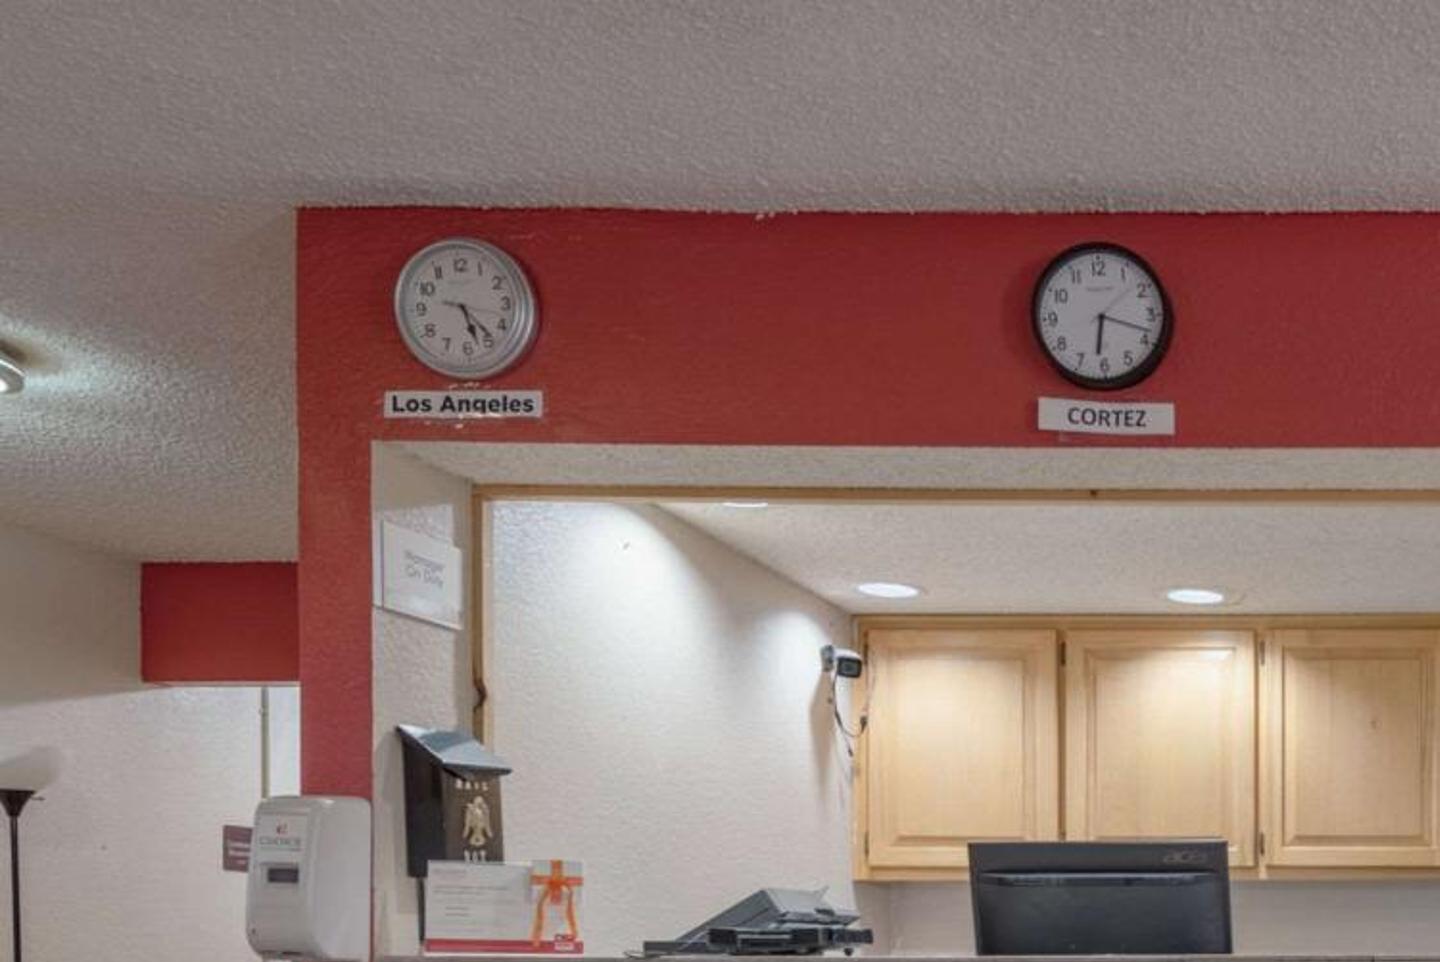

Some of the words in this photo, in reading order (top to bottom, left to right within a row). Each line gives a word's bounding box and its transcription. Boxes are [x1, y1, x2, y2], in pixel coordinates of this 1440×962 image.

[453, 259, 467, 272] 12
[1092, 262, 1105, 276] 12
[493, 276, 503, 290] 2
[1071, 270, 1081, 284] 11
[420, 282, 434, 296] 10
[1055, 289, 1068, 303] 10
[1137, 283, 1147, 297] 2
[416, 303, 427, 316] 9
[502, 297, 511, 311] 3
[1048, 312, 1057, 326] 9
[1146, 308, 1155, 322] 3
[425, 324, 436, 337] 8
[498, 318, 506, 330] 4
[442, 337, 451, 350] 7
[1057, 337, 1066, 351] 8
[1140, 333, 1148, 345] 4
[463, 341, 473, 355] 6
[1077, 353, 1084, 367] 7
[1101, 358, 1109, 372] 6
[1124, 352, 1132, 365] 5
[393, 396, 432, 412] Los
[440, 396, 534, 413] Angeles
[1068, 408, 1146, 427] CORTEZ
